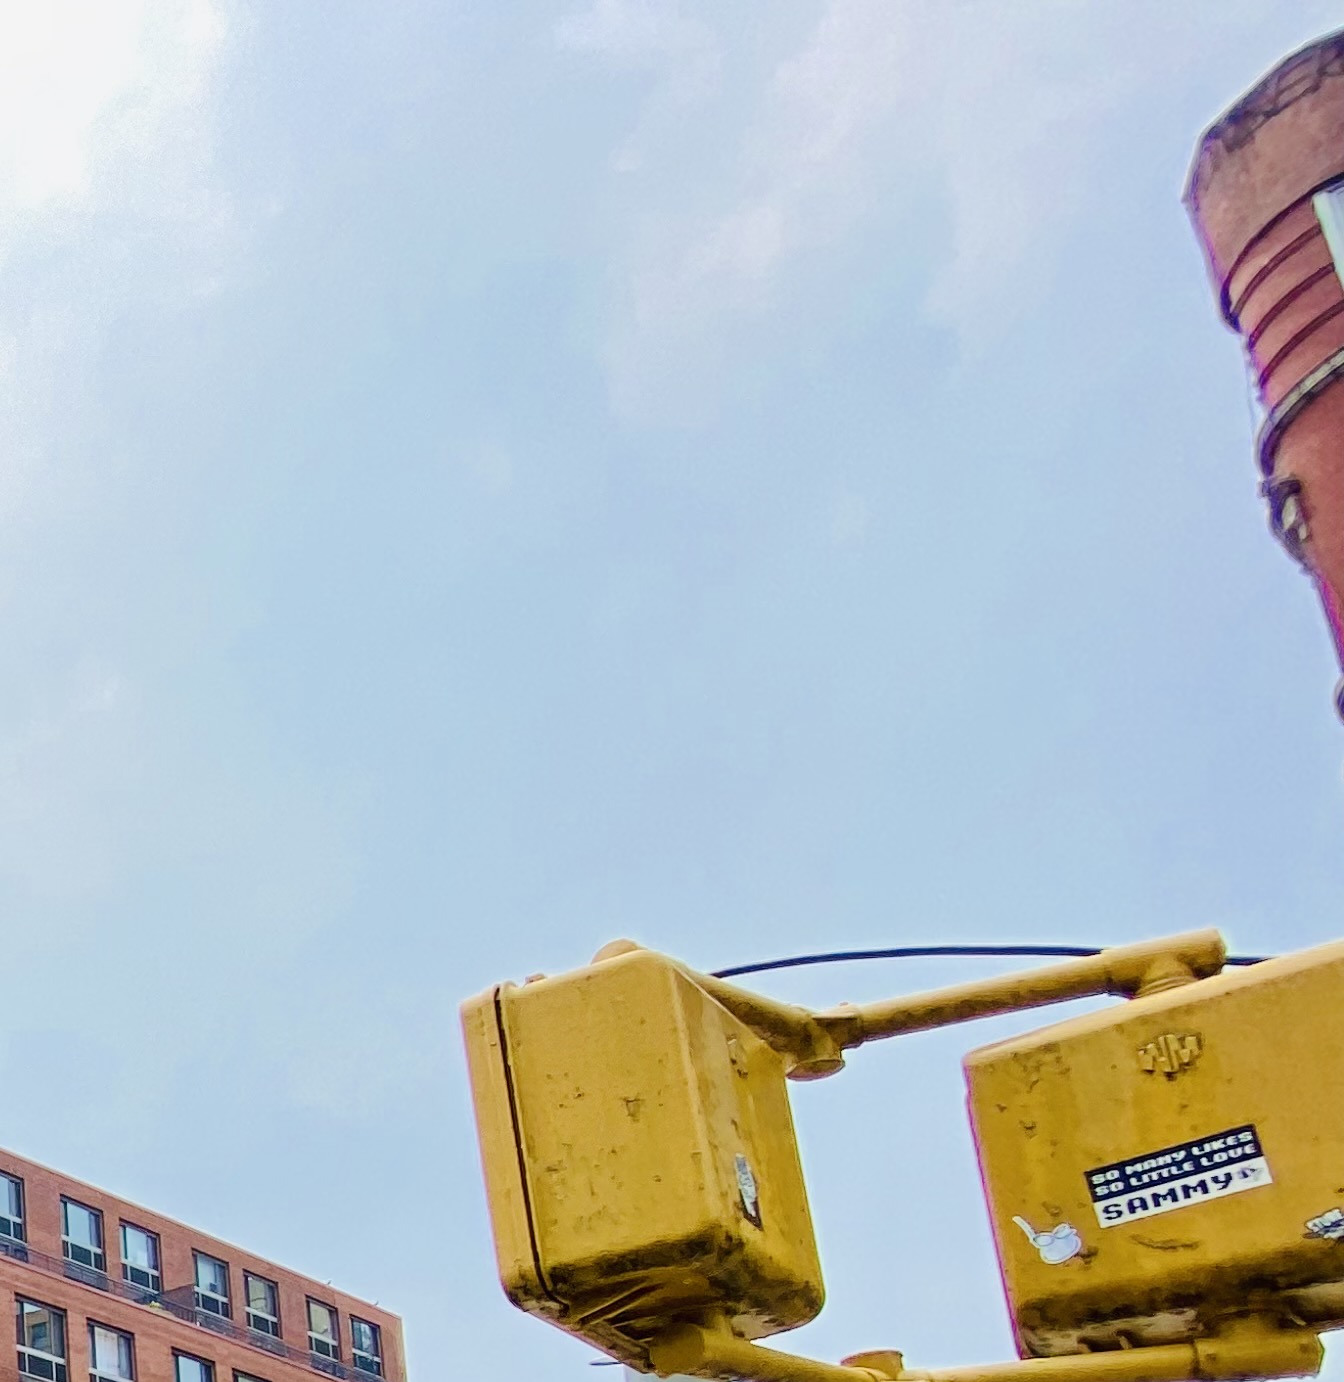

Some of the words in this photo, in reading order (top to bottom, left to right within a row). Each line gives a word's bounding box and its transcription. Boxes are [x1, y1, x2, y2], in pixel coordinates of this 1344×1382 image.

[1090, 1170, 1119, 1185] SO
[1125, 1150, 1187, 1175] MANY
[1191, 1131, 1254, 1156] LIKES
[1094, 1181, 1125, 1197] SO
[1130, 1161, 1195, 1187] LITTLE
[1199, 1143, 1257, 1167] LOVE
[1102, 1172, 1234, 1221] SAMMY
